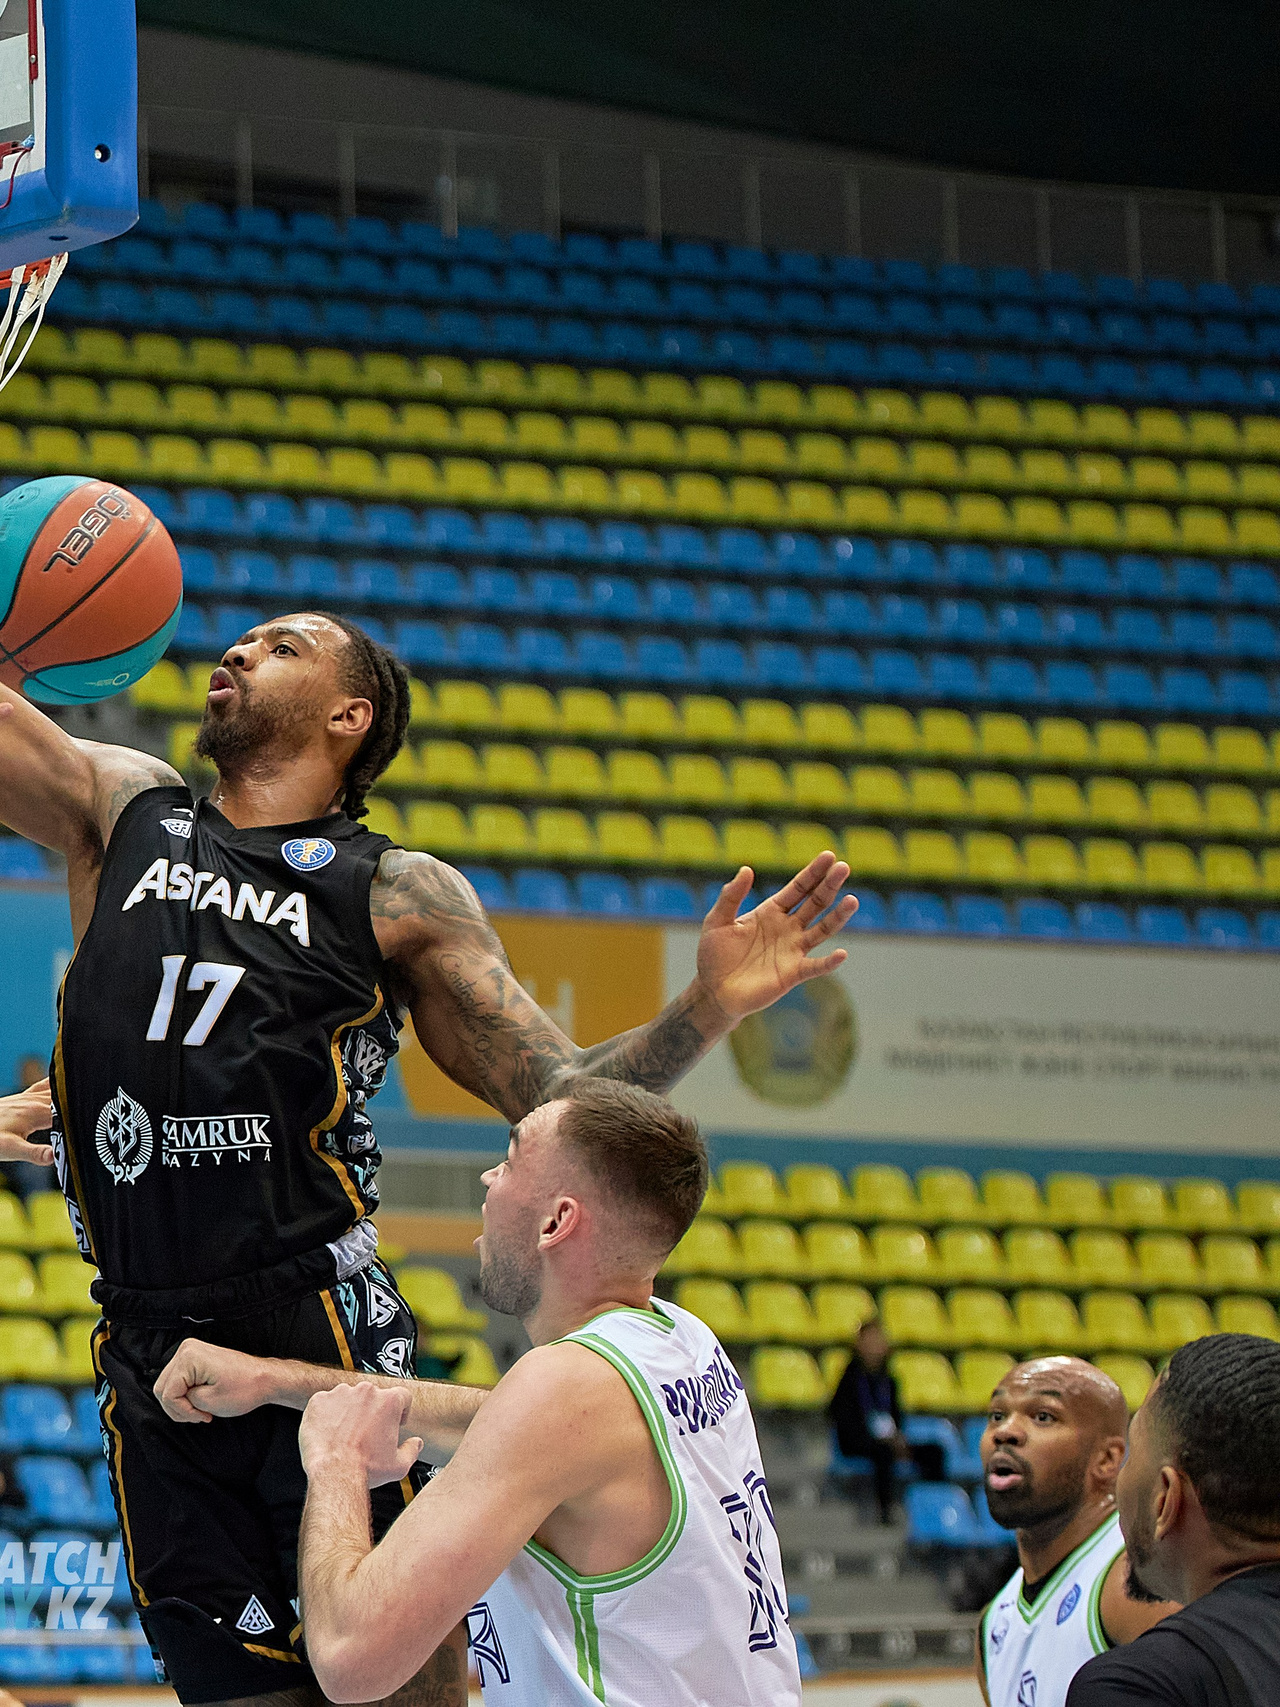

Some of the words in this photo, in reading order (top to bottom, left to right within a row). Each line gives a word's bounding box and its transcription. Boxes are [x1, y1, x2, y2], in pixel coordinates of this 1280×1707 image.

[41, 488, 132, 573] ÖGEL
[122, 857, 311, 947] ASTANA
[146, 954, 247, 1046] 17
[162, 1147, 271, 1168] KAZYNA
